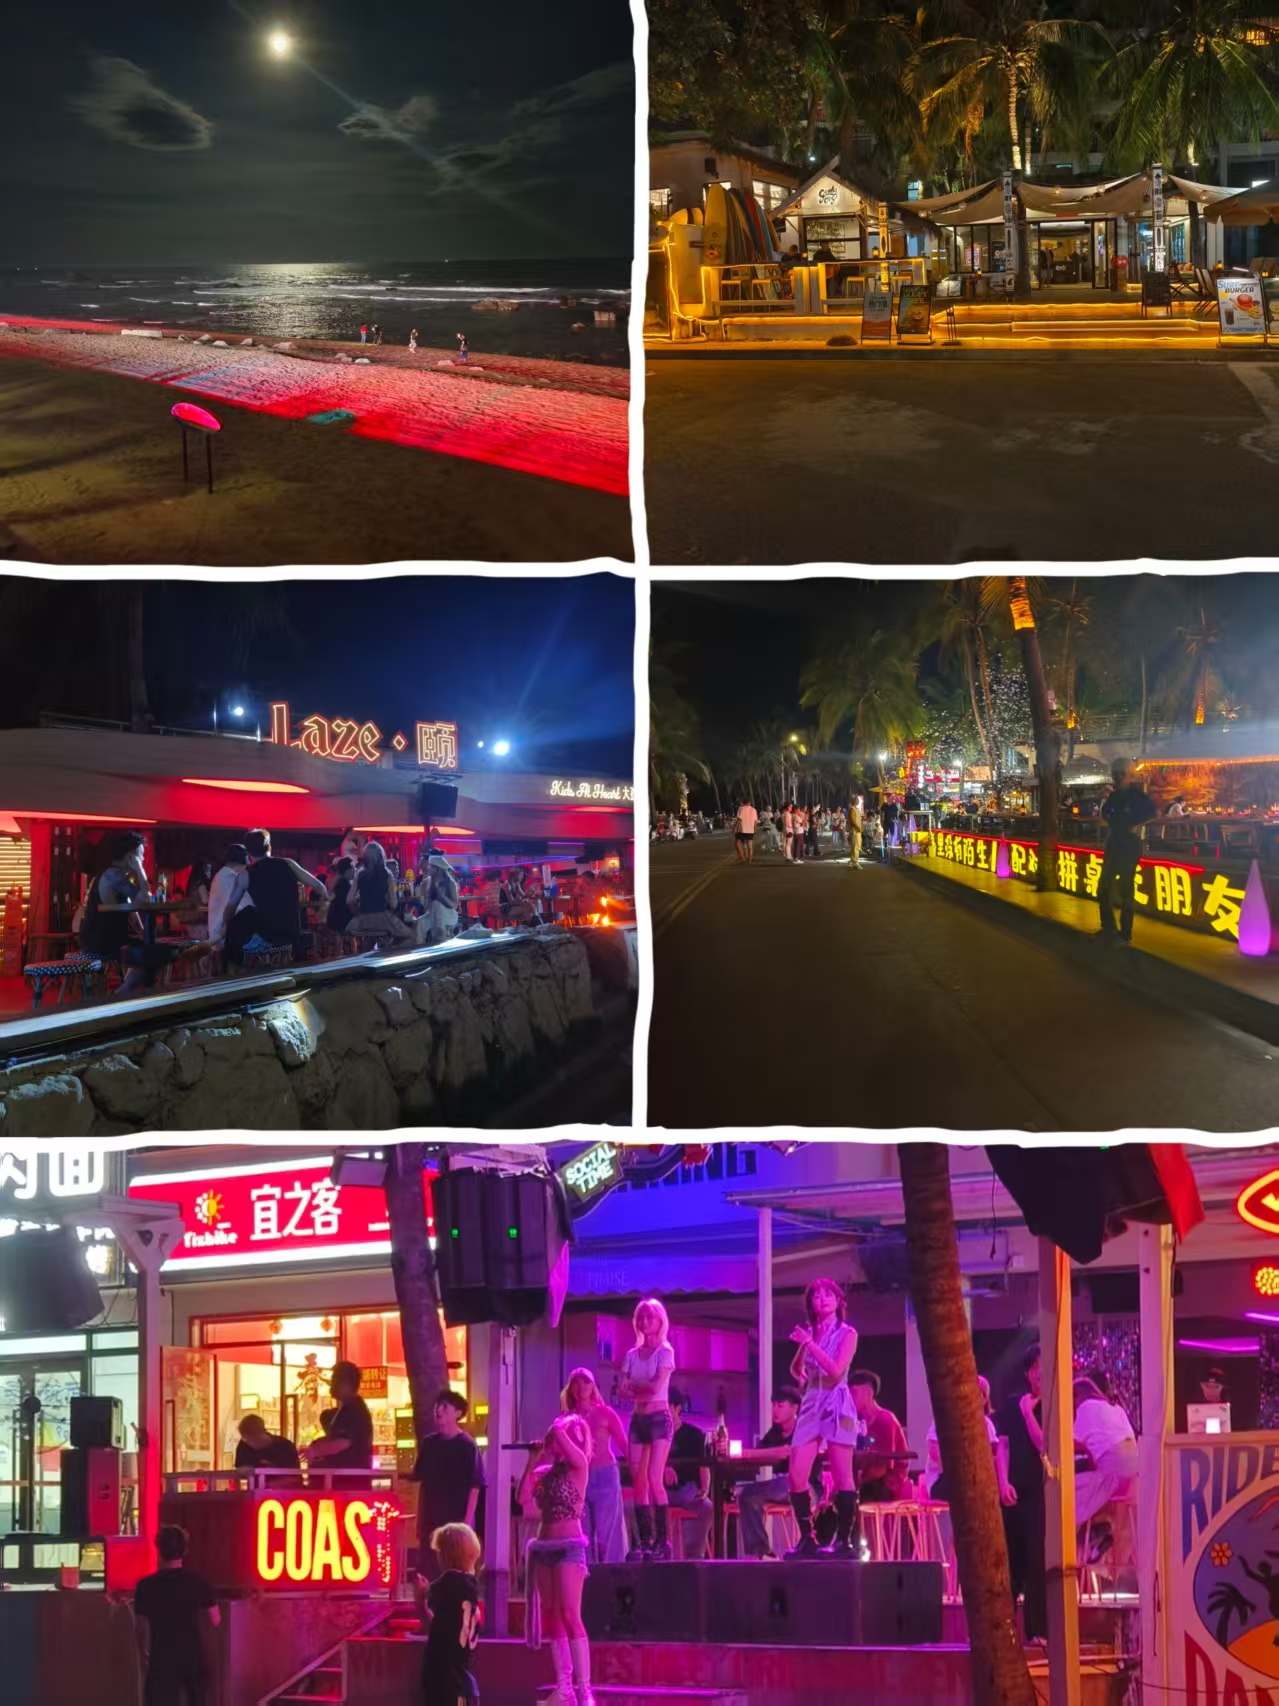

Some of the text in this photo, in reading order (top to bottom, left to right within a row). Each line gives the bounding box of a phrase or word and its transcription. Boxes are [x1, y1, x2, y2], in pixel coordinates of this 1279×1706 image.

[272, 704, 381, 761] Laze
[565, 1143, 616, 1185] SOCIAL
[576, 1164, 614, 1193] TIME
[250, 1177, 342, 1240] 宜之客
